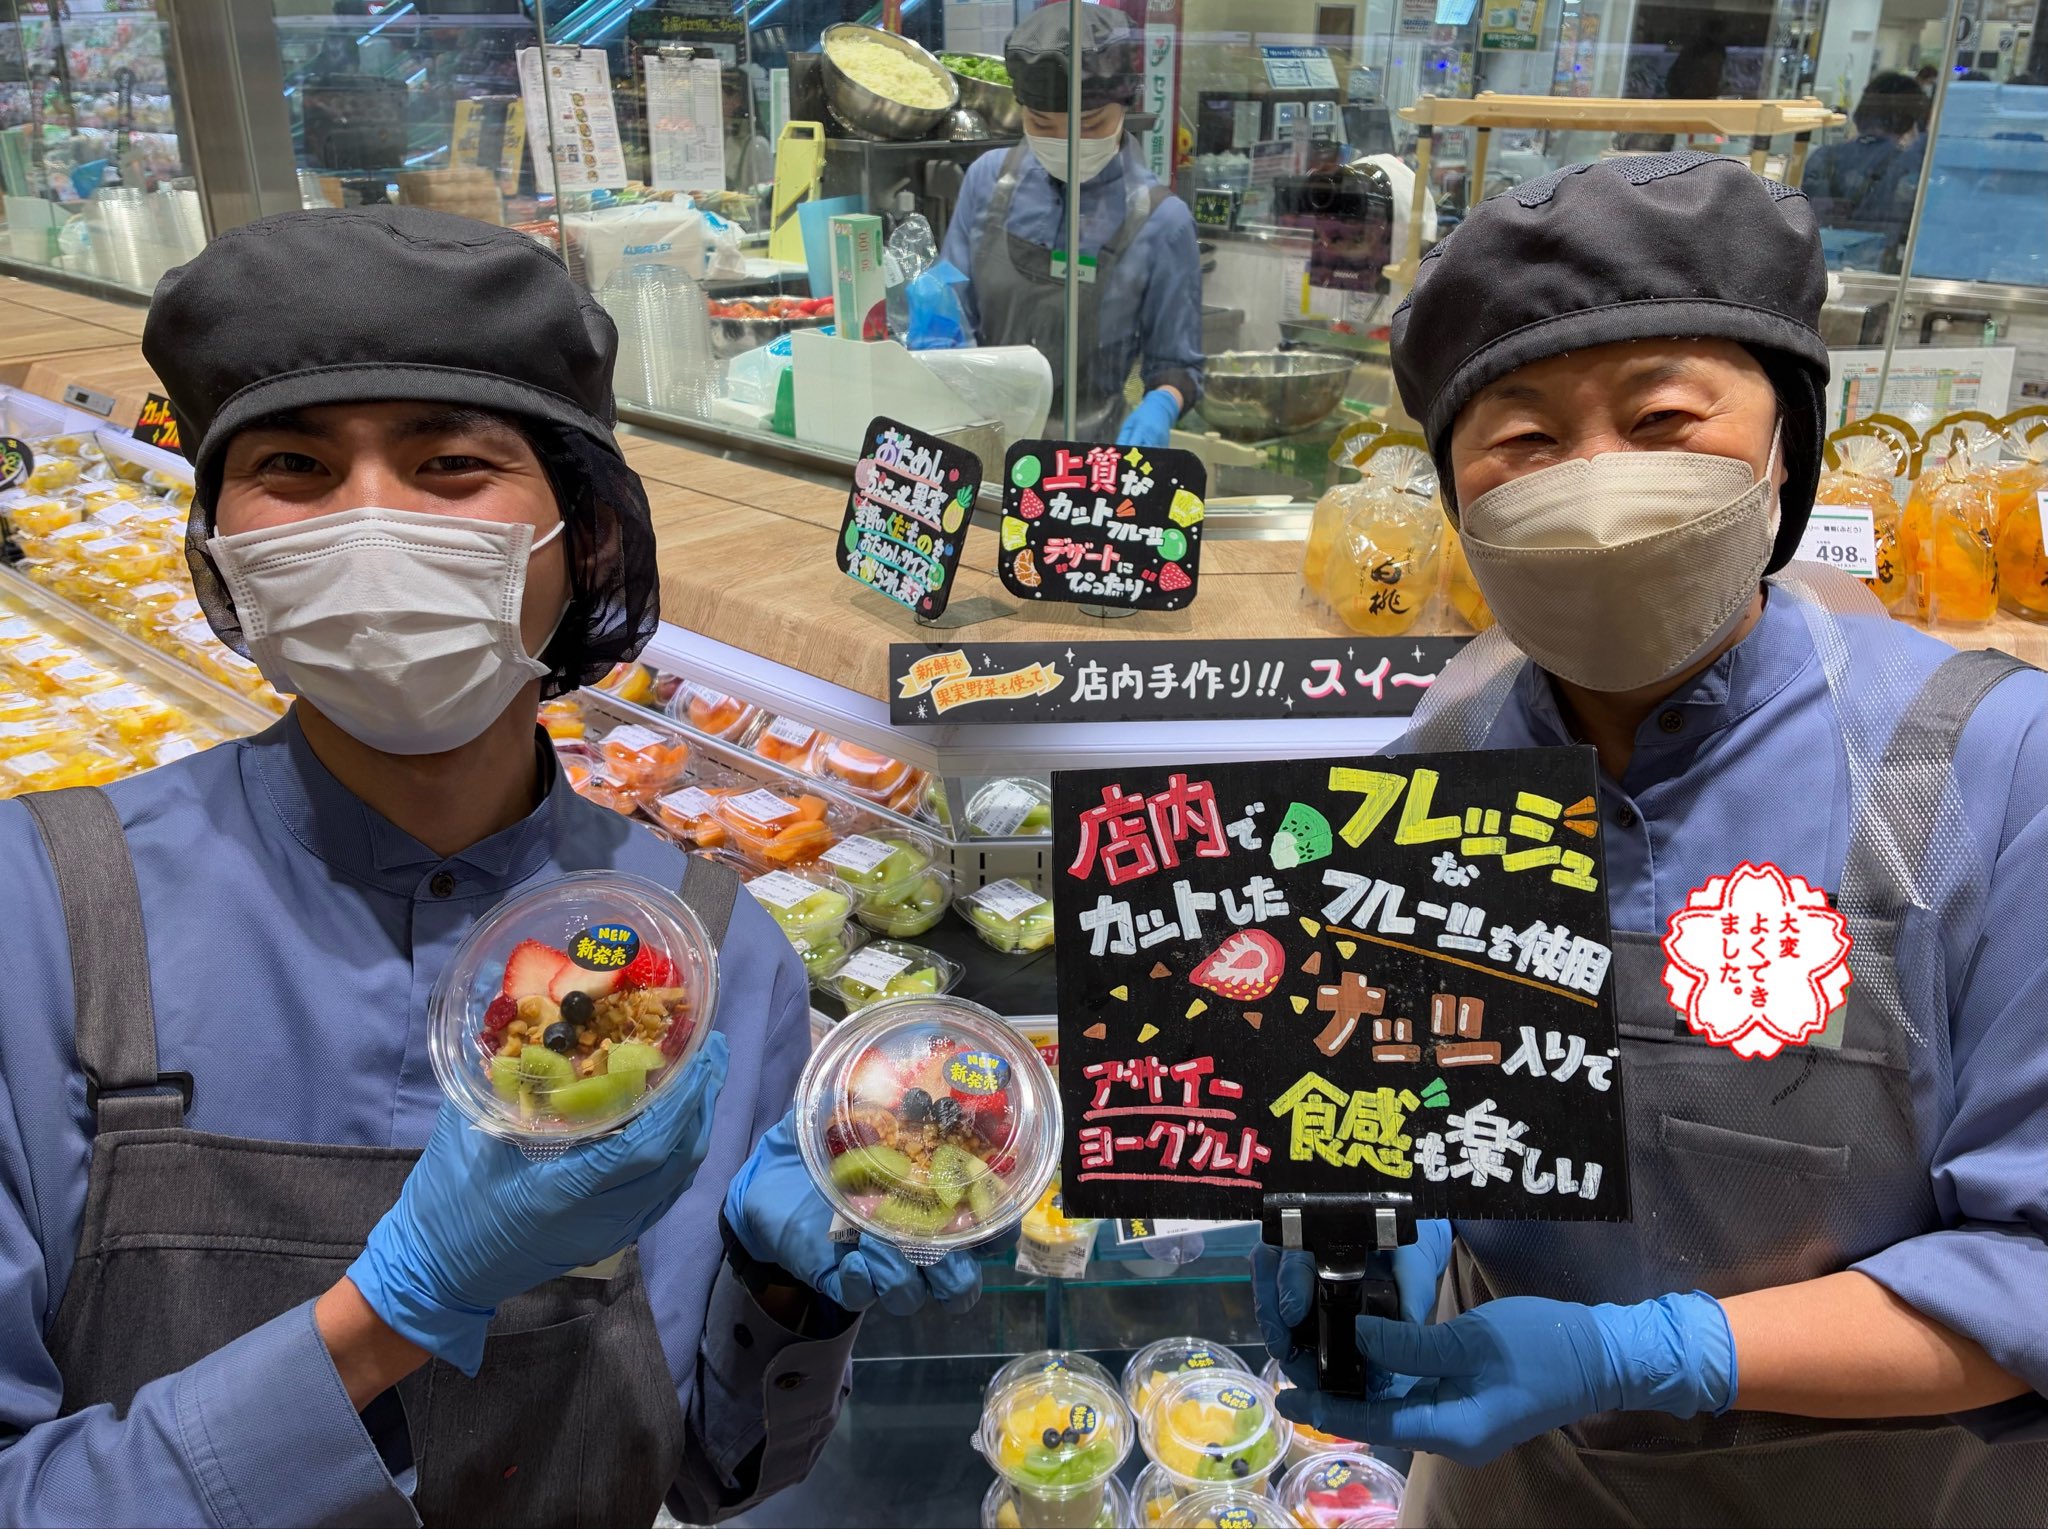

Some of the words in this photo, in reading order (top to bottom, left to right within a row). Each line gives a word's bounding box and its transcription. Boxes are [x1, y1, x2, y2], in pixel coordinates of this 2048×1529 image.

[876, 427, 945, 483] おためし
[1043, 447, 1155, 496] 上質な
[1043, 537, 1133, 573] デザートに
[916, 656, 963, 680] 新鮮な
[936, 670, 1043, 706] 果実野菜を使って
[1070, 659, 1284, 703] 店内手作り!!
[1301, 657, 1453, 700] スイ〜
[1068, 773, 1266, 885] 店内で
[1327, 767, 1598, 892] フレッシュ
[598, 927, 631, 942] NEW
[1078, 875, 1290, 956] カットした
[1321, 869, 1614, 995] フルーツを使用
[576, 937, 627, 967] 新発売
[950, 1062, 998, 1091] 新発売
[967, 1055, 999, 1069] NEW
[1082, 1055, 1243, 1110] アサイー
[1078, 1121, 1272, 1173] ヨーグルト
[1269, 1071, 1602, 1200] 食感も楽しい
